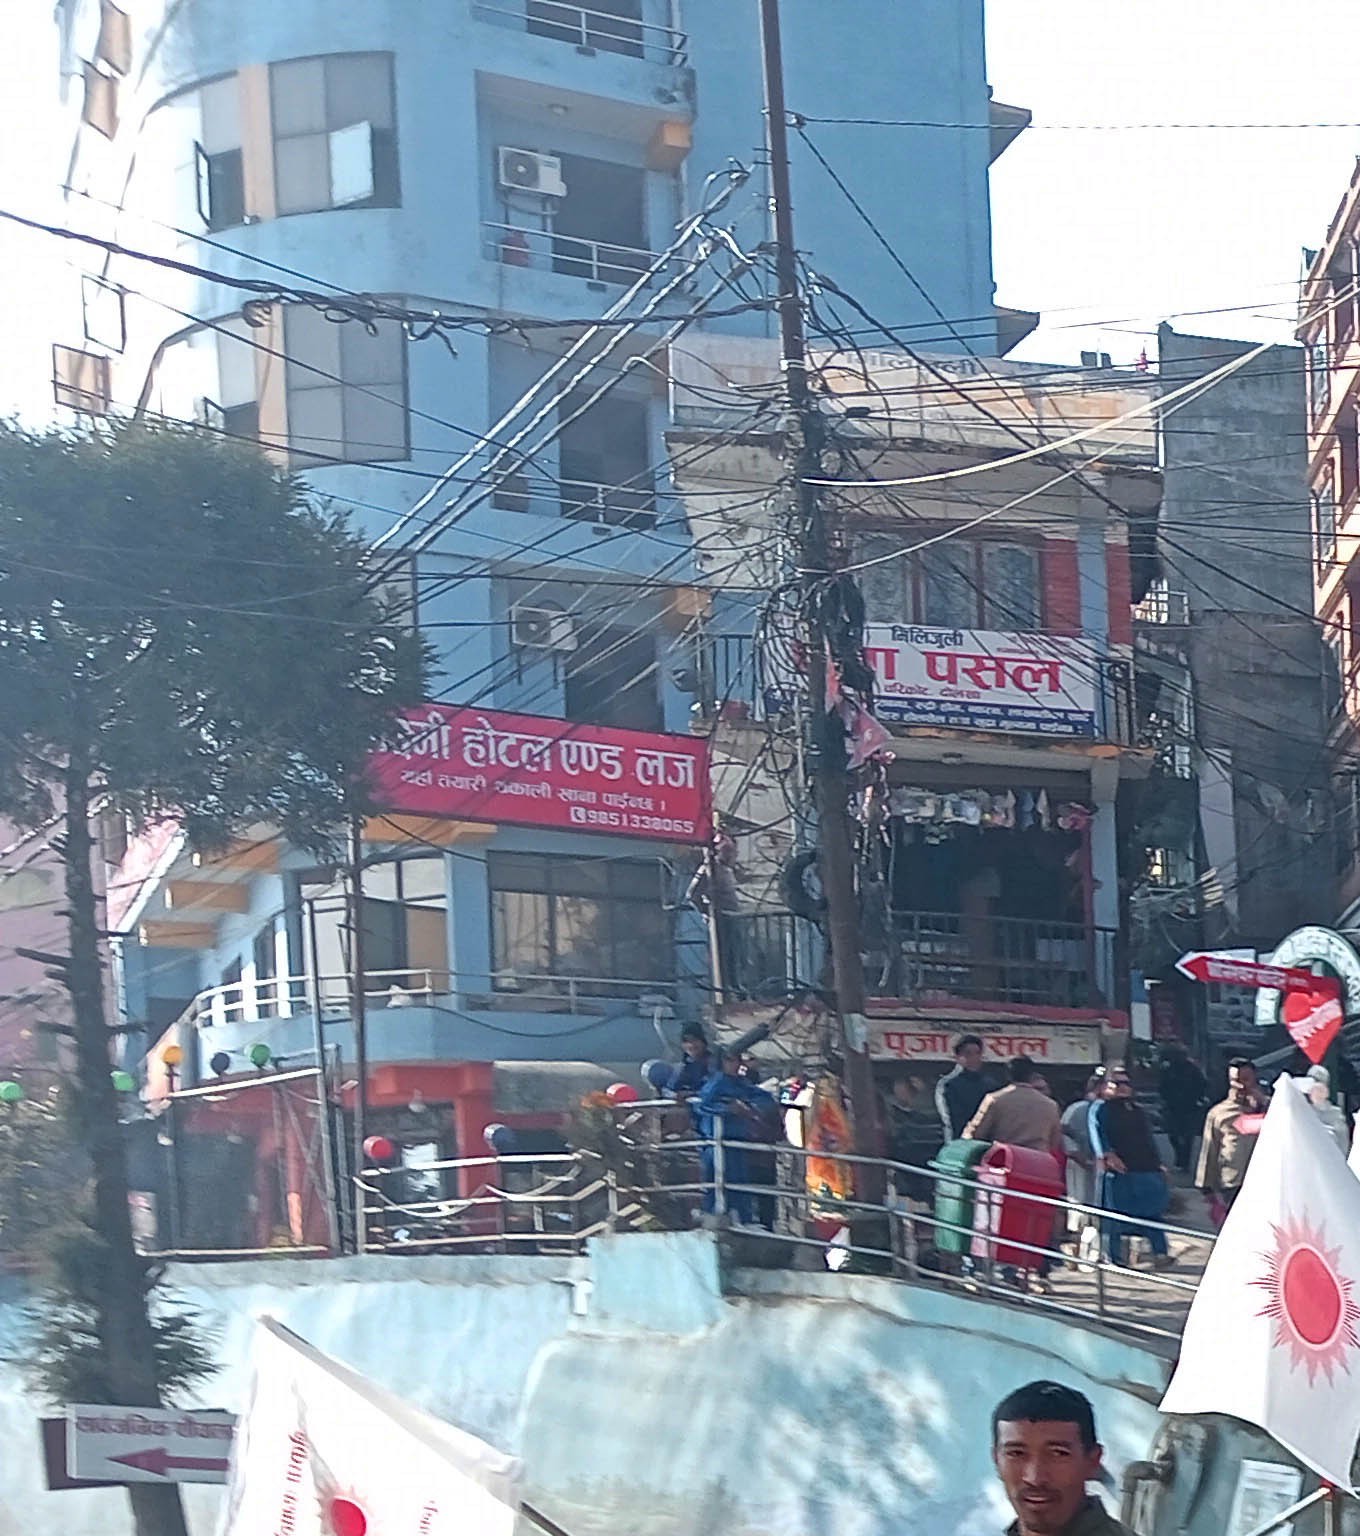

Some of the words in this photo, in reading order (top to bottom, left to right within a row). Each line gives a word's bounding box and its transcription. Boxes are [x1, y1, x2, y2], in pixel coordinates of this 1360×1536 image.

[923, 651, 1064, 692] पसल
[461, 717, 552, 771] होटल
[559, 739, 624, 780] एण्ड
[635, 748, 696, 789] लज
[982, 1035, 1049, 1057] सल
